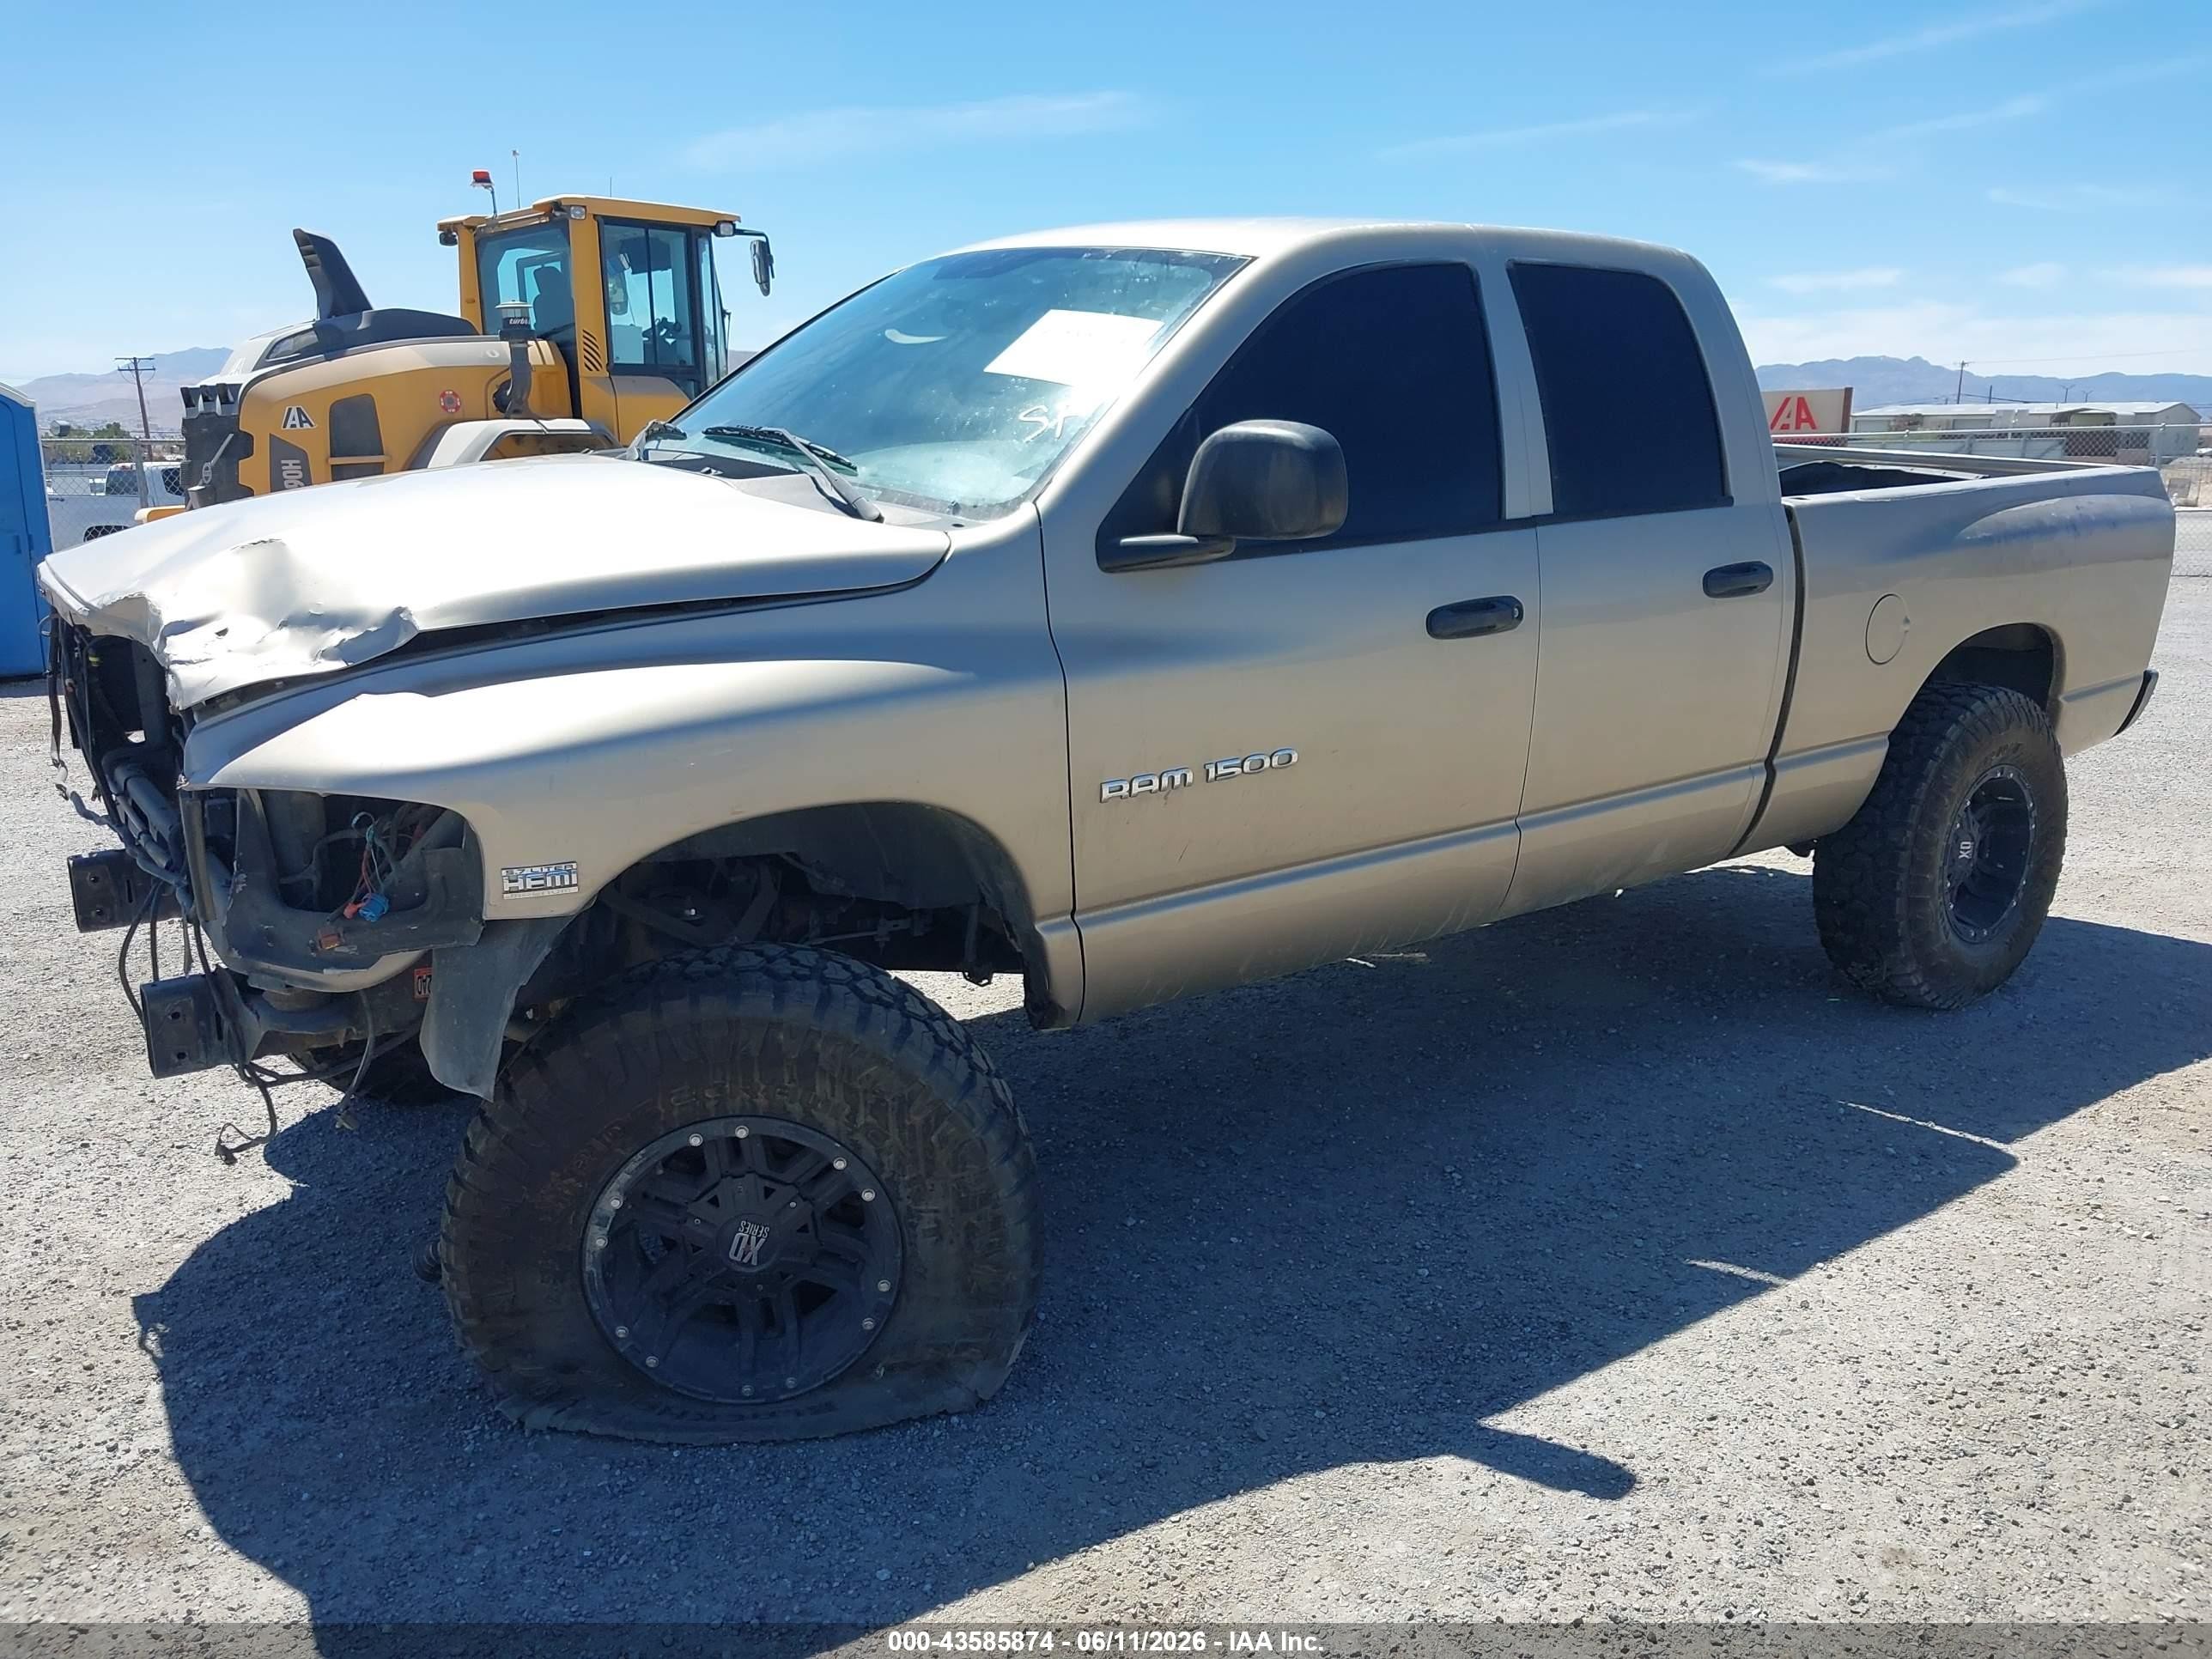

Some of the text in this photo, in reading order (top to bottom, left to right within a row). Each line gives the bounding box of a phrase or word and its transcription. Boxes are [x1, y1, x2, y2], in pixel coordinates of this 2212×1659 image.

[1100, 747, 1298, 803] RAM 1500
[502, 869, 578, 892] HEMI
[738, 1220, 770, 1238] SERIES
[729, 1232, 767, 1266] XD
